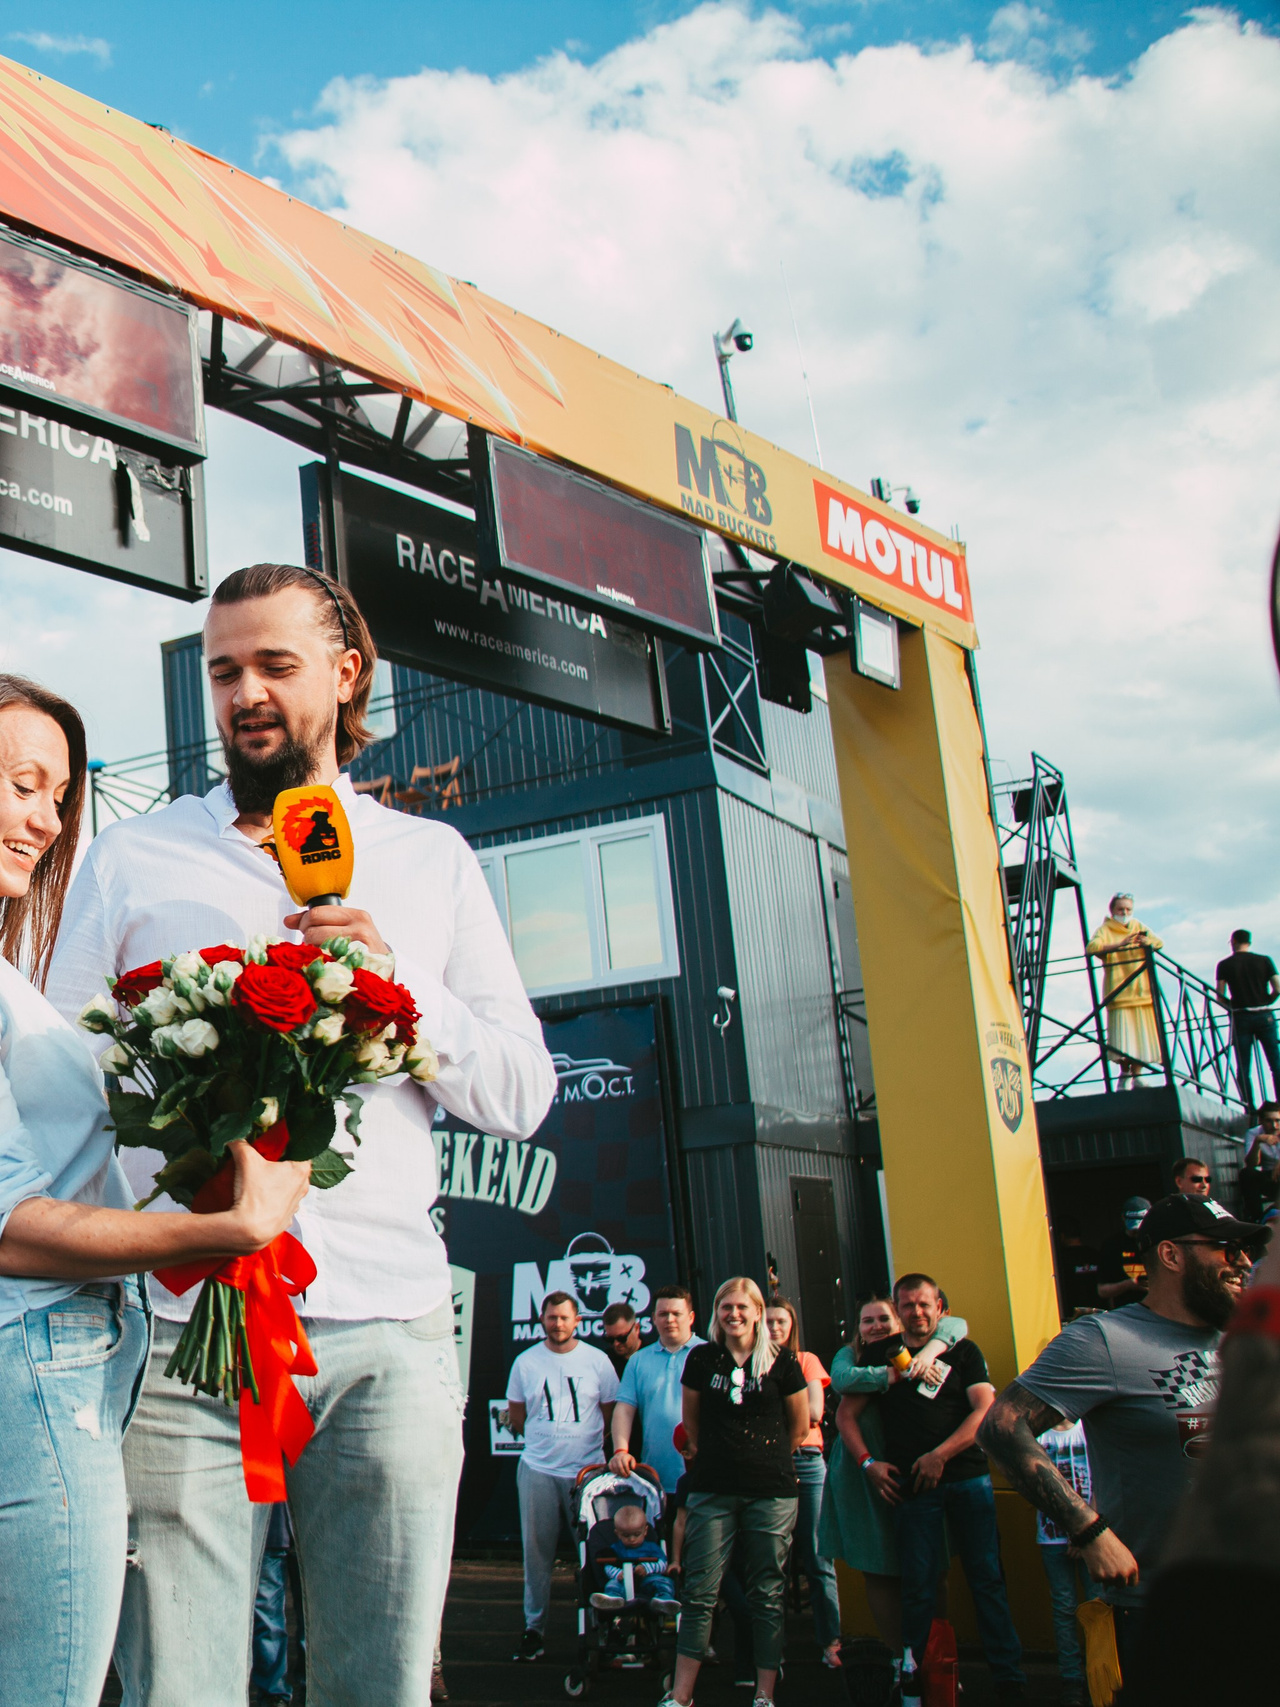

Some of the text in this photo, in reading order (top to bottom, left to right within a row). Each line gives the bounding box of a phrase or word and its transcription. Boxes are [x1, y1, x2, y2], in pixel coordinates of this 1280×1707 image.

[681, 492, 778, 553] MAD BUCKETS
[827, 496, 963, 612] MOTUL
[434, 618, 589, 681] www.raceamerica.com
[300, 849, 342, 866] RDRC
[431, 1130, 558, 1217] EKEND
